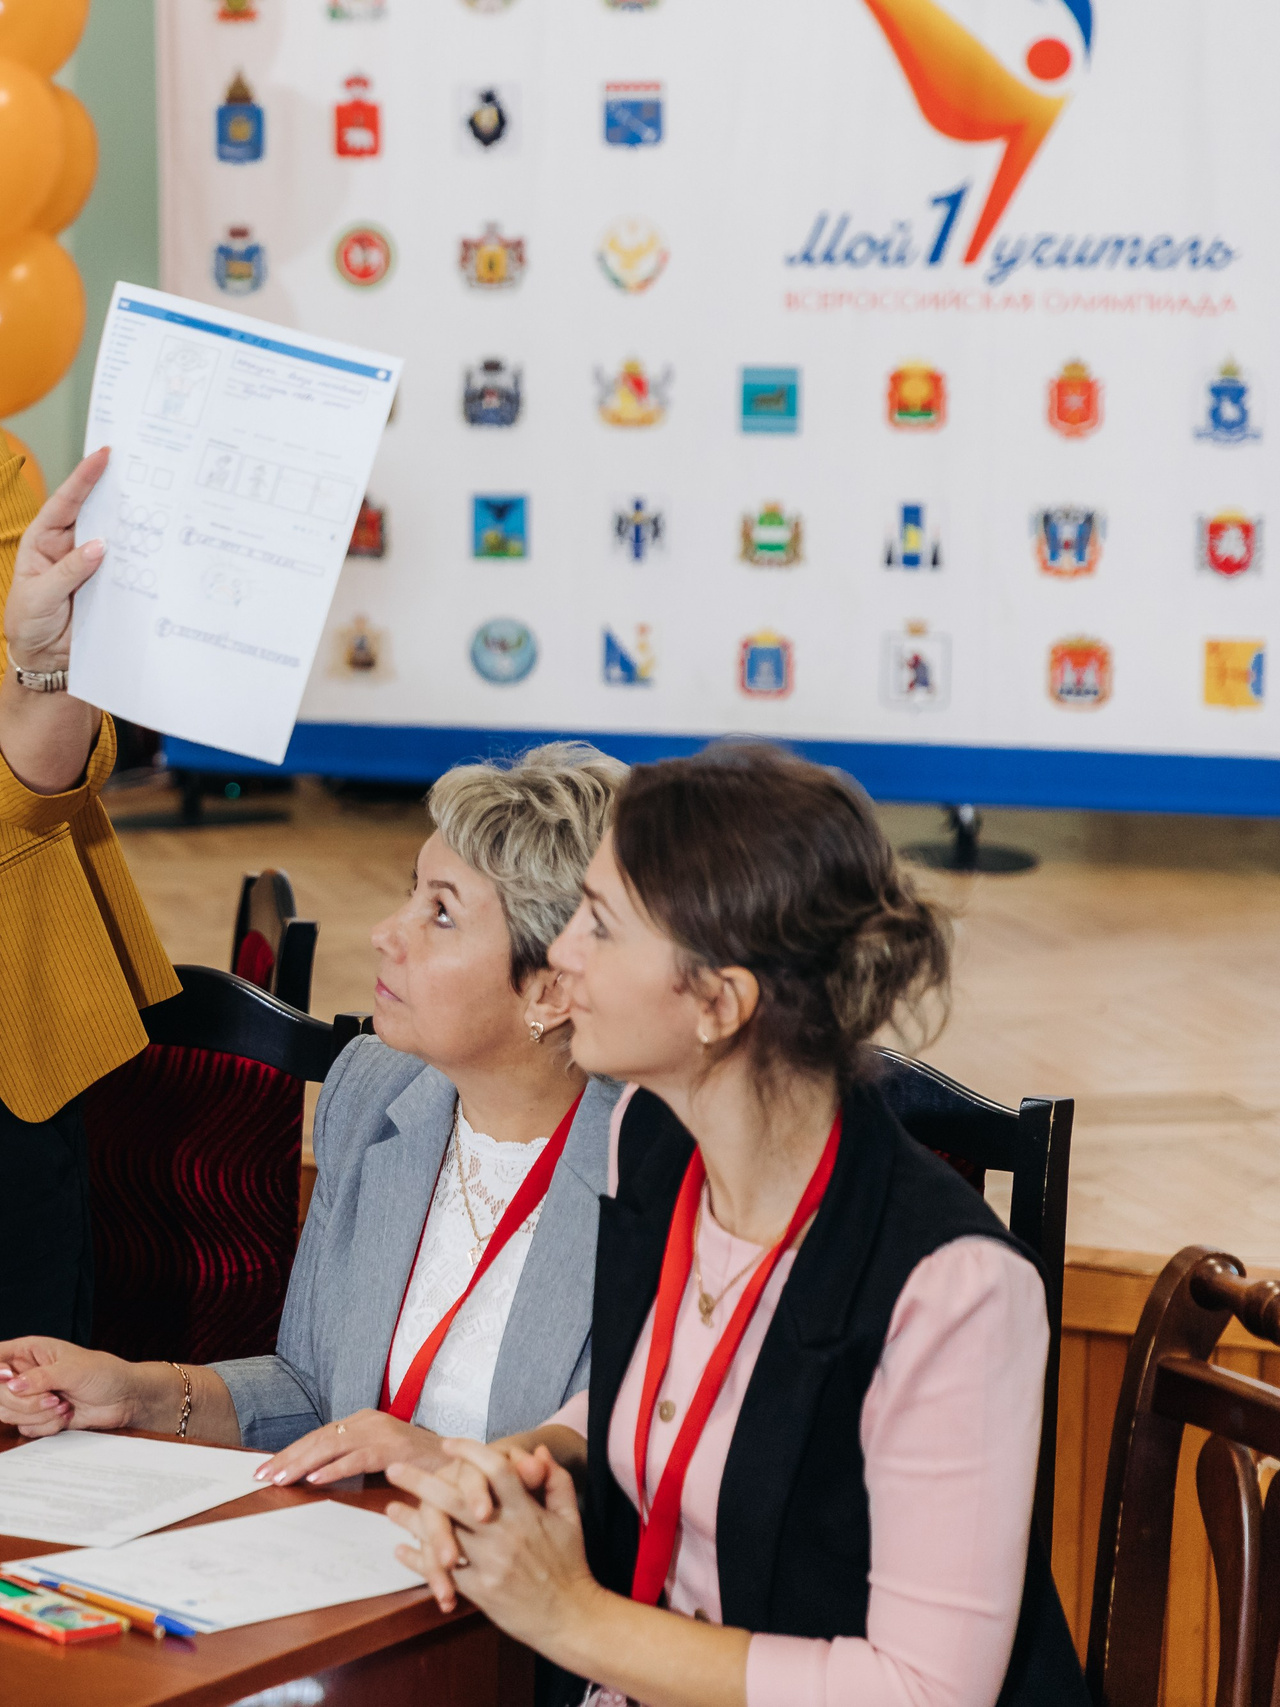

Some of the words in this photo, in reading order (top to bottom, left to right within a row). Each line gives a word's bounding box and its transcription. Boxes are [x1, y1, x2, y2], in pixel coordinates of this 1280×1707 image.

[785, 210, 918, 268] Мой
[984, 232, 1240, 285] учитель
[784, 289, 1034, 314] ВСЕРОССИЙСКАЯ
[1042, 288, 1238, 317] ОЛИМПИАДА
